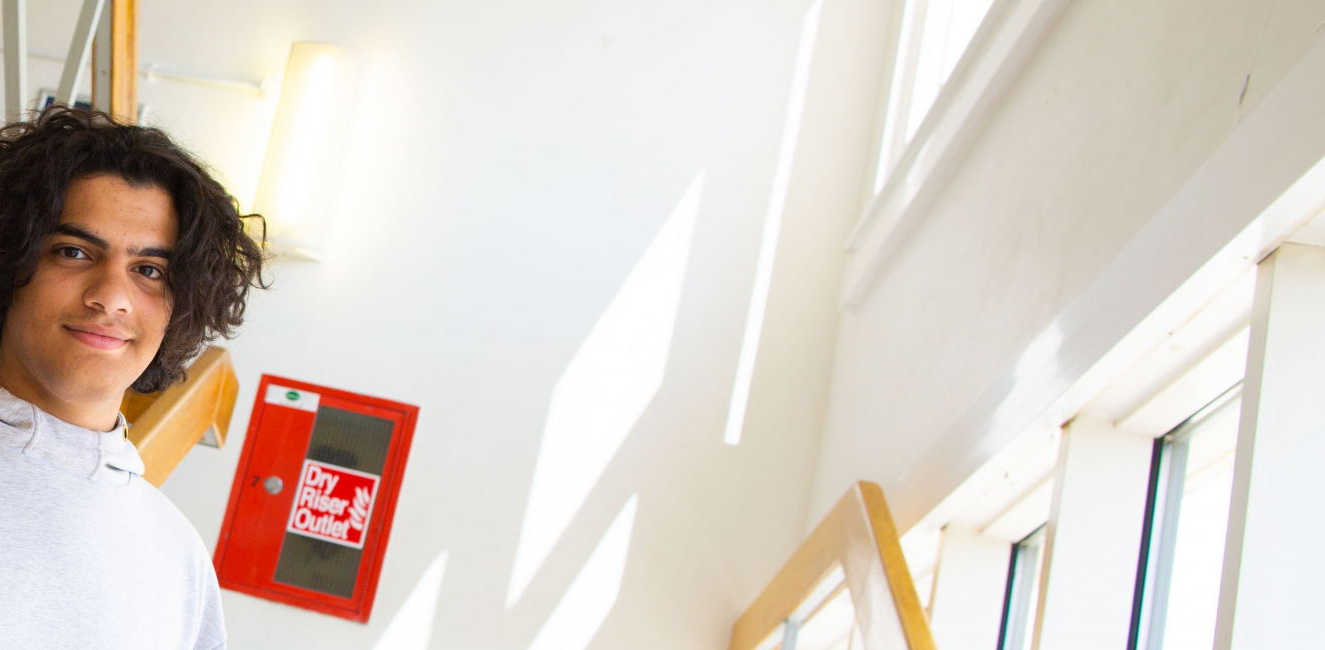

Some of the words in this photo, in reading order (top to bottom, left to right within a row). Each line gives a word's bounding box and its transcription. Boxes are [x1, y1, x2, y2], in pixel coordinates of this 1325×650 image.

[306, 466, 339, 494] Dry
[299, 487, 349, 515] Riser
[295, 508, 350, 539] Outlet
